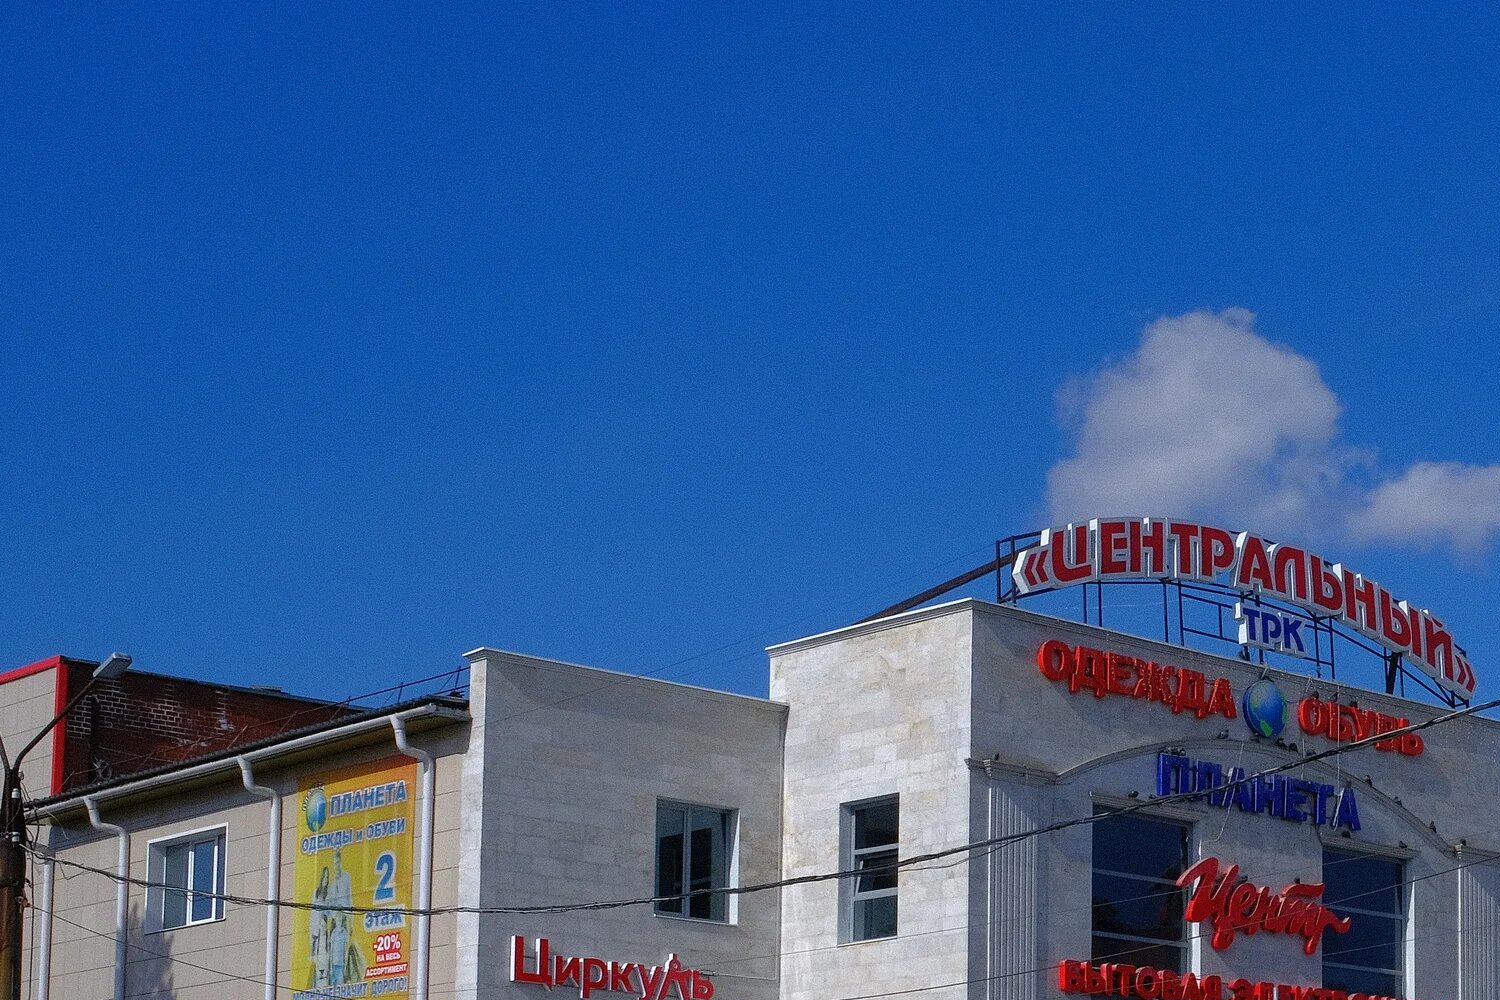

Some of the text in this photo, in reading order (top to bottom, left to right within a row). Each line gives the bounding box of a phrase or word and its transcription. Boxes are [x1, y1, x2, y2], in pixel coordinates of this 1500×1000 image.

[1237, 603, 1306, 656] ТРК
[1037, 639, 1425, 757] ОДЕЖДА ОБУВЬ
[330, 779, 408, 817] ПЛАНЕТА
[1156, 752, 1363, 831] ПЛАНЕТА
[301, 829, 353, 855] ОДЕЖДЫ
[366, 817, 406, 840] ОБУВИ
[374, 852, 396, 901] 2
[1175, 856, 1351, 955] Центр
[374, 932, 401, 951] -20%
[366, 964, 408, 977] АССОРТИМЕНТ
